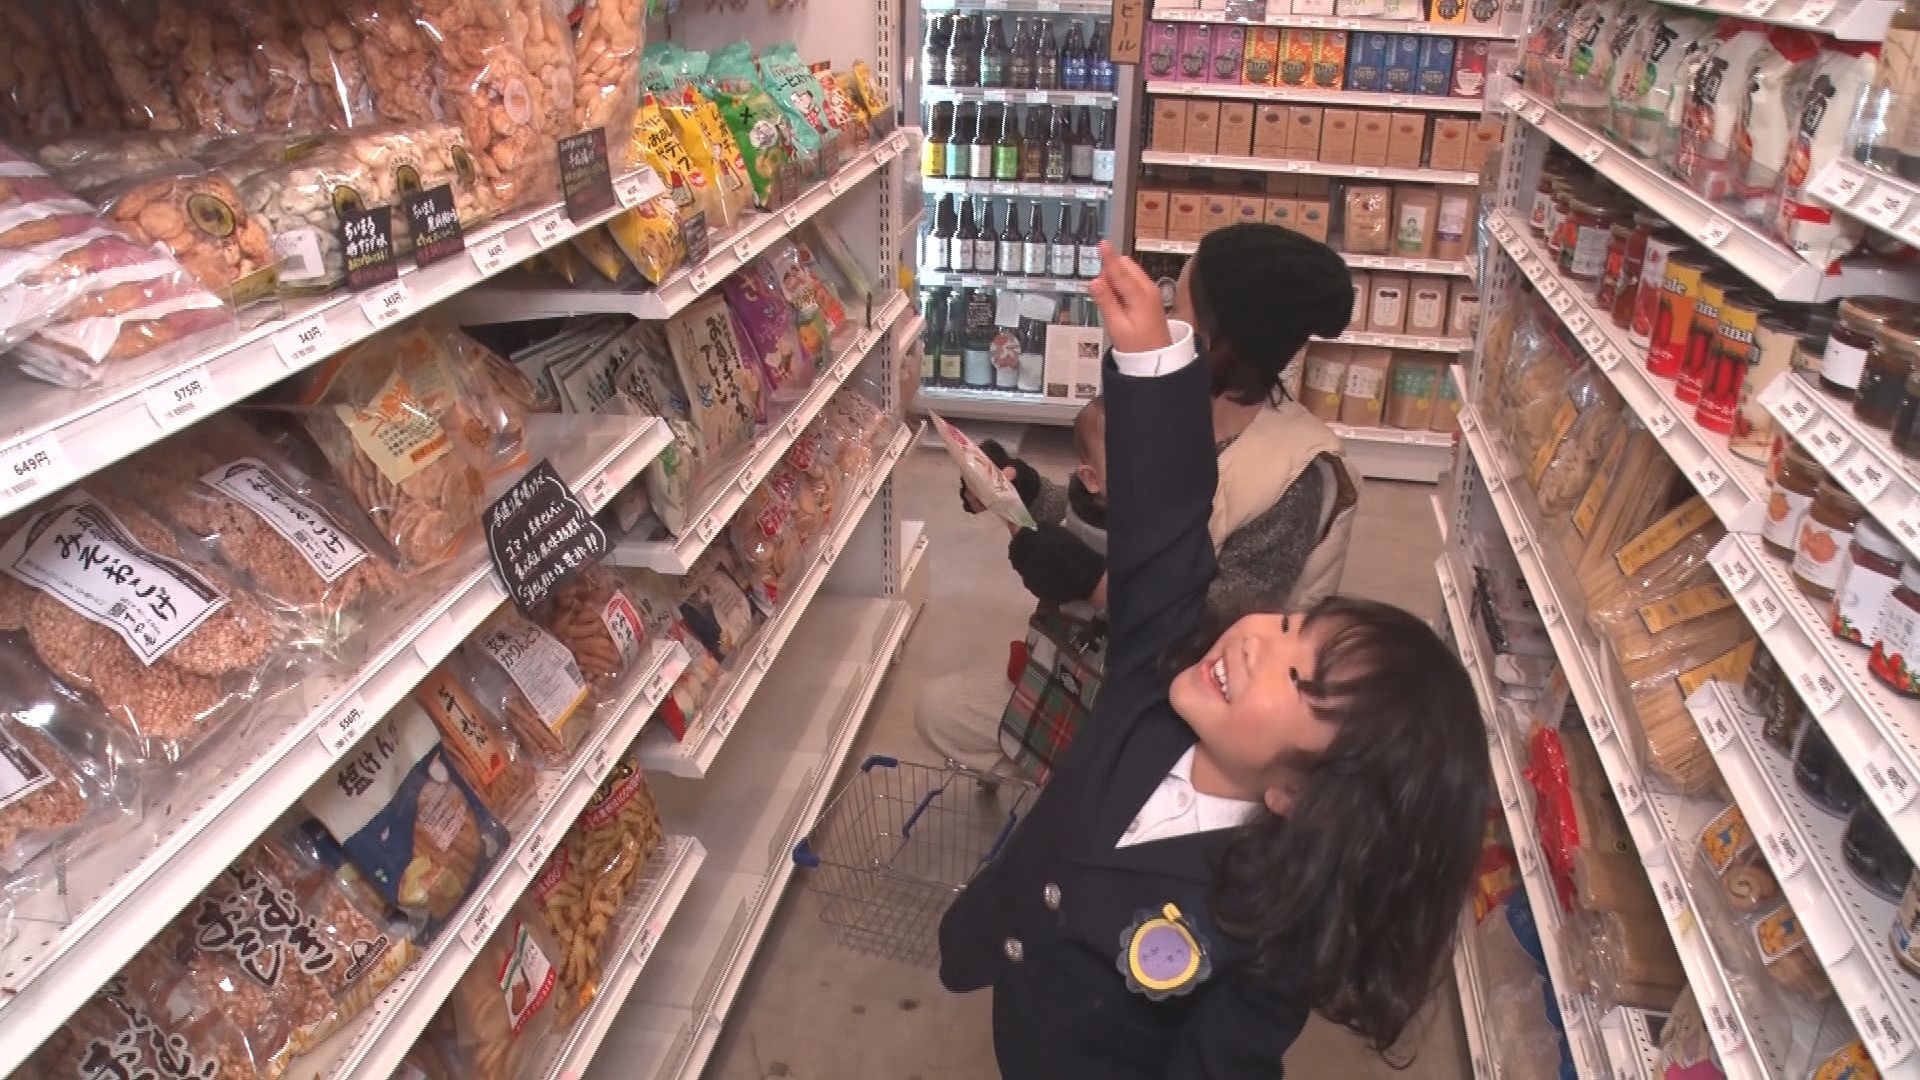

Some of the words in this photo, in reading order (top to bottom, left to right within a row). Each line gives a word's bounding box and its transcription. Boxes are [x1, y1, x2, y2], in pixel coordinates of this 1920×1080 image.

[299, 326, 322, 346] 343円
[174, 380, 202, 402] 575円
[13, 450, 51, 476] 649円
[54, 533, 178, 621] みそおこげ
[500, 627, 542, 669] かりんとう
[236, 864, 336, 971] とむぎ
